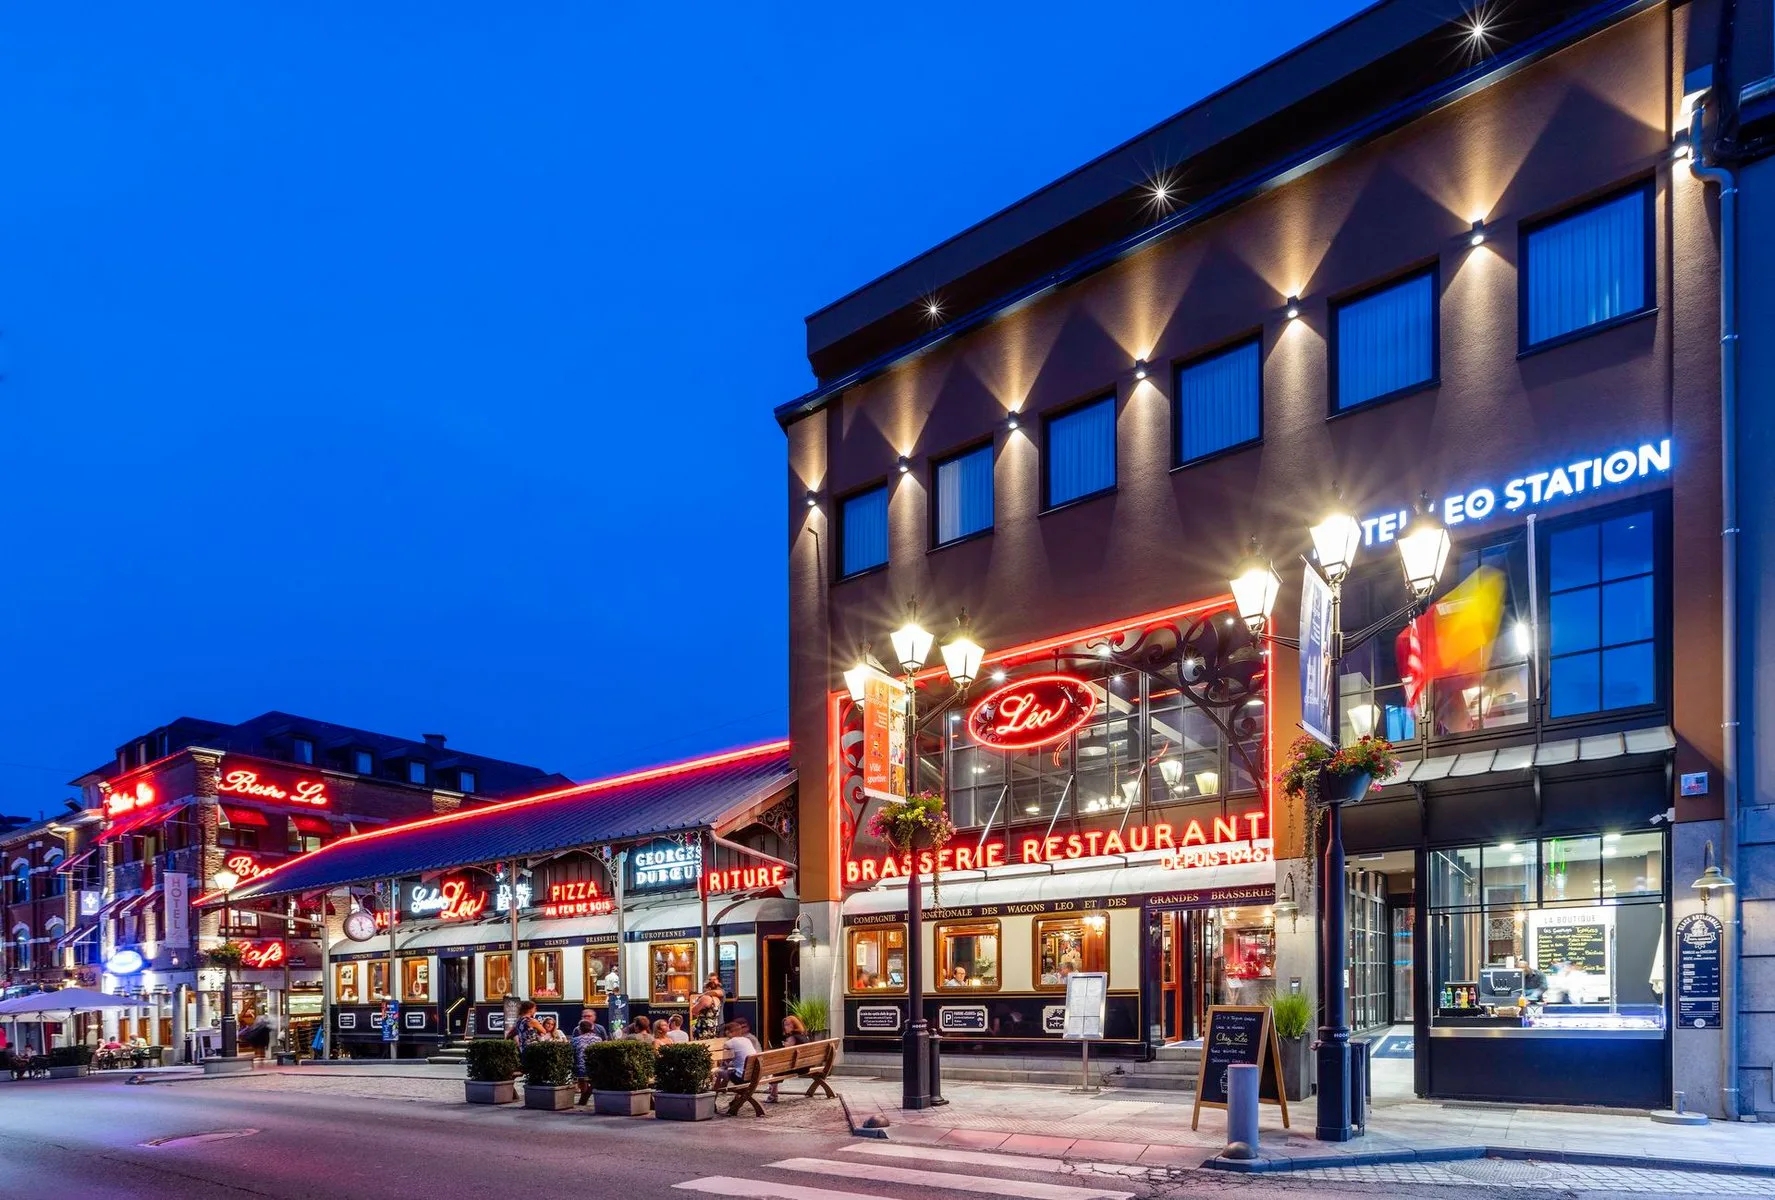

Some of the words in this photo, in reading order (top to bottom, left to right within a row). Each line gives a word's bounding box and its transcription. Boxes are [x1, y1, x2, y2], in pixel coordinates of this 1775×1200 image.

[1429, 488, 1495, 525] EO
[1504, 438, 1671, 511] STATION
[999, 692, 1067, 735] Léo
[218, 770, 286, 799] Bistro
[635, 845, 702, 868] GEORGES
[846, 843, 1004, 882] BRASSERIE
[1022, 810, 1266, 863] RESTAURANT
[1161, 852, 1219, 871] DEPUIS
[1226, 847, 1265, 864] 1946
[552, 881, 598, 901] PIZZA
[697, 864, 785, 891] RITURE
[171, 877, 182, 930] HOTEL
[440, 881, 486, 920] Léo
[545, 906, 556, 916] AU
[558, 904, 574, 914] FEU
[576, 903, 588, 913] DE
[590, 901, 611, 912] BOIS
[853, 914, 897, 924] COMPAGNIE
[904, 908, 973, 921] IRNATIONALE
[981, 906, 998, 915] DES
[1007, 902, 1045, 913] WAGONS
[1054, 901, 1074, 911] LEO
[1084, 899, 1097, 909] ET
[1108, 897, 1127, 907] DES
[1149, 893, 1199, 905] GRANDES
[544, 938, 569, 946] GRANDES
[640, 930, 687, 940] EUROPEENNES
